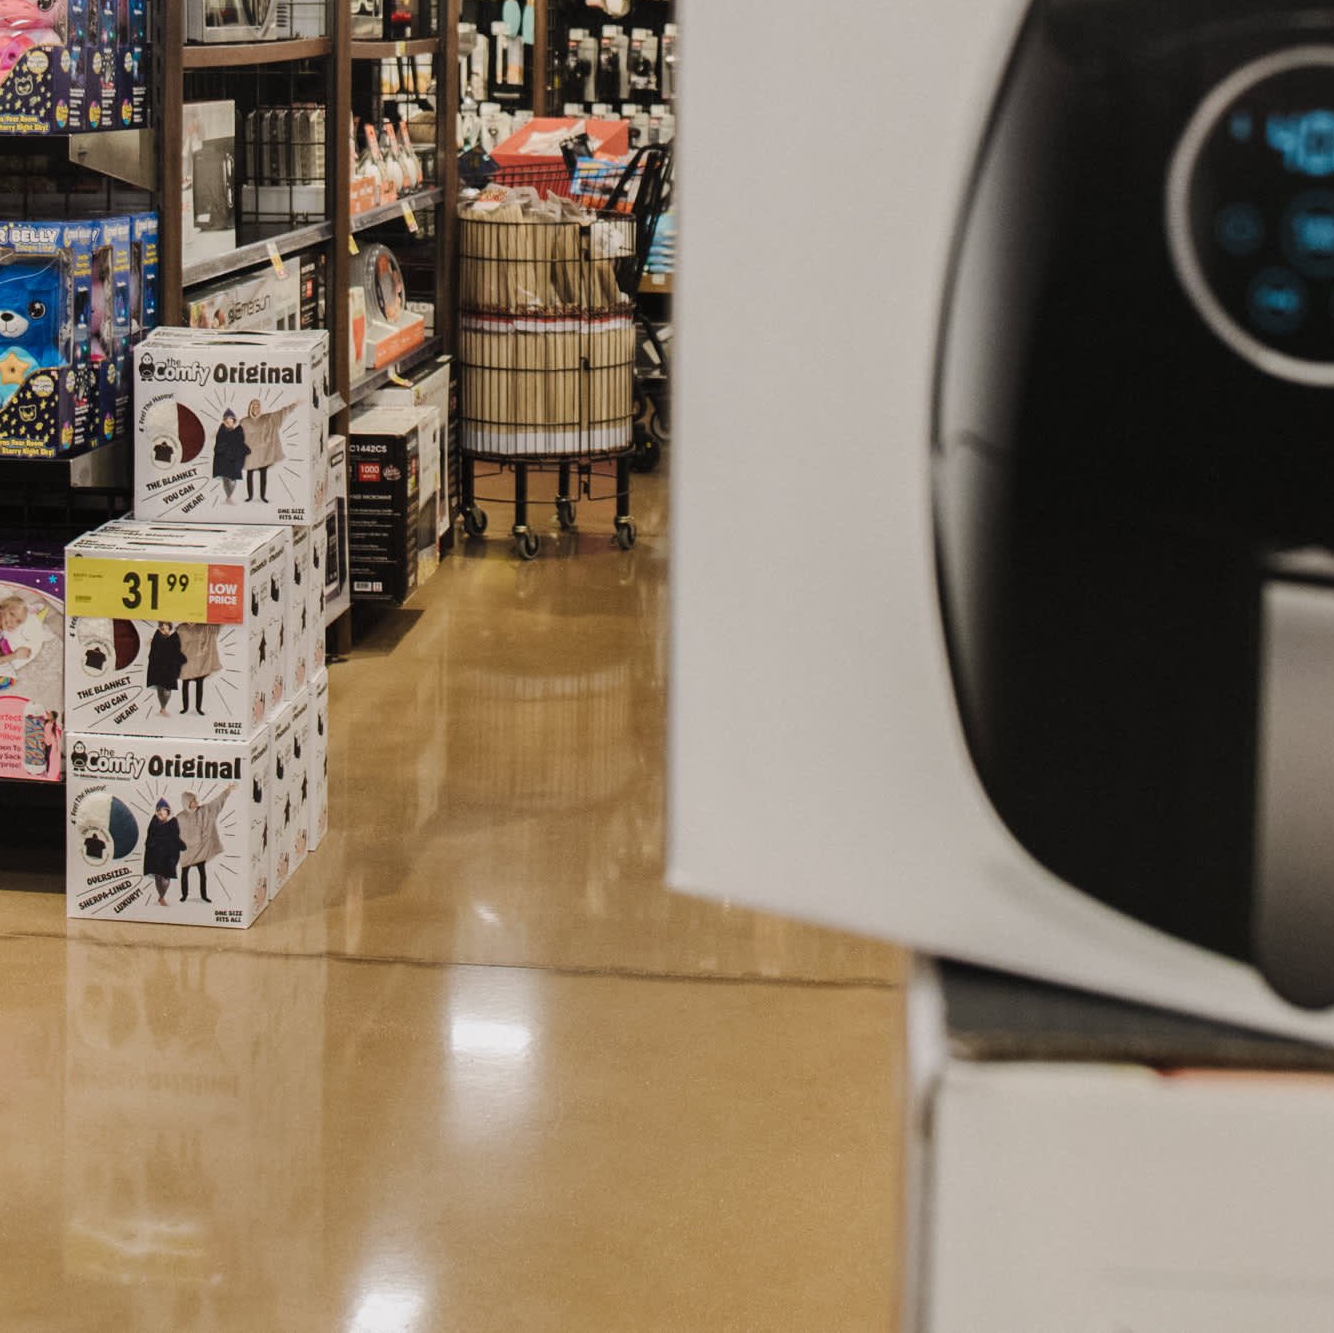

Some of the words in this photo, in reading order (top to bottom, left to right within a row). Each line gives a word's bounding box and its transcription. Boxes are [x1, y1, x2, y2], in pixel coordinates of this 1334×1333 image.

[9, 228, 59, 243] BELLY
[167, 358, 180, 366] the
[154, 362, 210, 386] Comfy
[214, 362, 302, 384] Original
[146, 480, 162, 491] THE
[163, 468, 198, 486] BLANKET
[360, 465, 379, 473] 1000
[163, 492, 179, 504] YOU
[179, 484, 195, 497] CAN
[181, 494, 205, 513] WEAR!
[209, 583, 237, 595] LOW
[209, 596, 237, 605] PRICE
[77, 687, 94, 700] THE
[94, 676, 131, 695] BLANKET
[94, 701, 111, 715] YOU
[111, 692, 128, 706] CAN
[113, 703, 139, 725] WEAR!
[4, 724, 22, 733] Play
[100, 747, 115, 756] the
[87, 751, 145, 779] Comfy
[148, 754, 241, 779] Original
[87, 867, 132, 885] OVERSIZED.
[79, 880, 132, 910] SHERPA-LINED
[113, 889, 144, 914] LUXURY!
